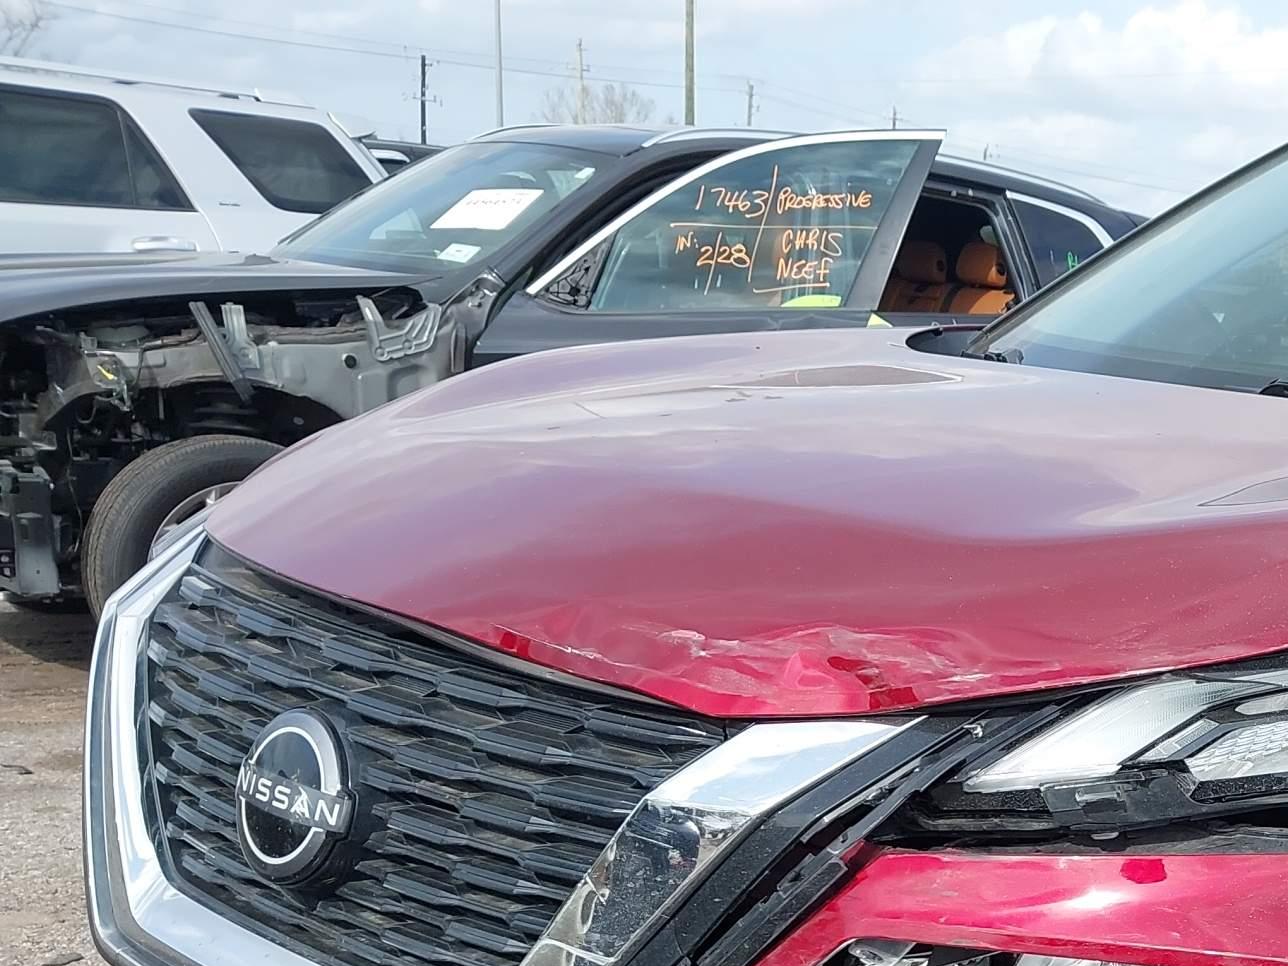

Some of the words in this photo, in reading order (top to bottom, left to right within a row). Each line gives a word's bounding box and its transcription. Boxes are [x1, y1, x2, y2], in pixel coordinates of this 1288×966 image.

[695, 184, 769, 218] 17463
[777, 187, 872, 214] PROGRESSIVE
[782, 228, 843, 257] CHRIS
[237, 766, 340, 826] NISSAN
